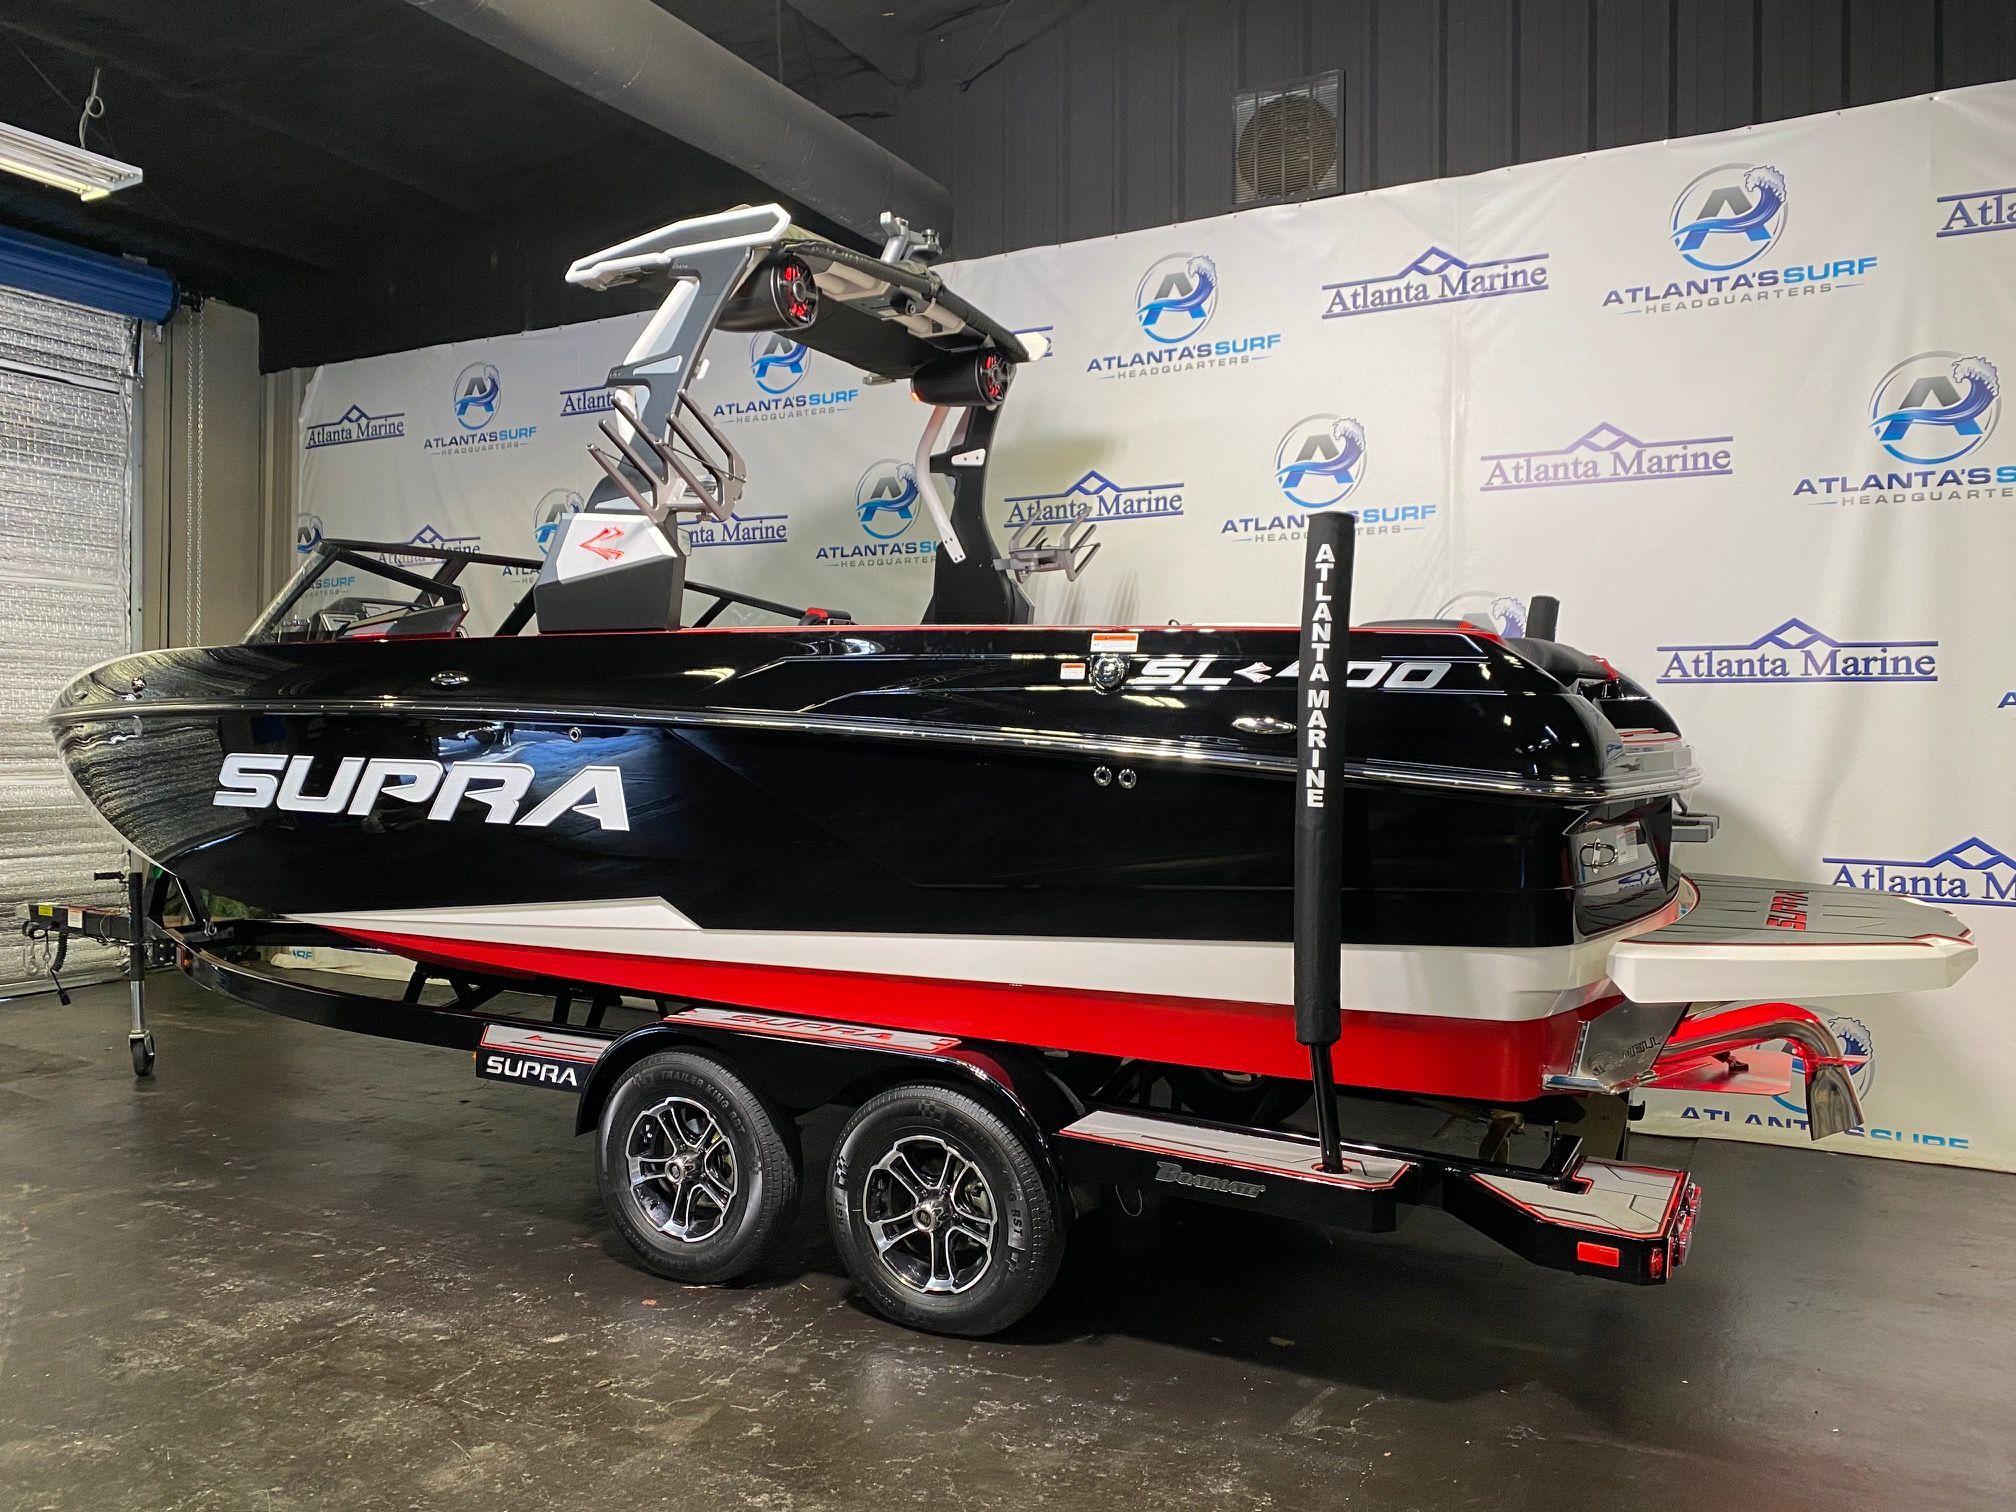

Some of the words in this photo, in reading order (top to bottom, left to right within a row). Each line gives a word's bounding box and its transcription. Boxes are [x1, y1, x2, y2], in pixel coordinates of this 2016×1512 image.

[1325, 279, 1430, 314] Atlanta
[1438, 264, 1547, 298] Marine
[1602, 270, 1779, 307] ATLANTA'S
[1783, 256, 1878, 284] SURF
[1645, 283, 1832, 315] HEADQUARTERS
[1087, 343, 1212, 373] ATLANTA'S
[1215, 333, 1281, 355] SURF
[1117, 355, 1250, 380] HEADQUARTERS
[713, 395, 807, 417] ATLANTA'S
[808, 389, 859, 405] SURF
[736, 406, 835, 424] HEADQUARTERS
[308, 426, 353, 446] Atlanta
[357, 418, 404, 439] Marine
[424, 431, 498, 449] ATLANTA'S
[499, 426, 538, 440] SURF
[441, 441, 519, 457] HEADQUARTERS
[1485, 456, 1600, 486] Atlanta
[1610, 444, 1731, 477] Marine
[1792, 467, 1992, 496] ATLANTA'S
[1007, 499, 1090, 523] Atlanta
[1096, 489, 1183, 517] Marine
[1363, 504, 1437, 524] SURF
[721, 519, 787, 542] Marine
[815, 542, 918, 560] ATLANTA'S
[1309, 543, 1336, 682] ATLANTA
[1134, 659, 1232, 686] SL
[1660, 650, 1790, 678] Atlanta
[1800, 647, 1936, 677] Marine
[1306, 689, 1330, 808] MARINE
[213, 752, 630, 832] SUPRA
[1832, 864, 1969, 898] Atlanta
[1766, 890, 1809, 931] SUPRA
[723, 1014, 893, 1041] SUPRA
[485, 1055, 577, 1087] SUPRA
[661, 1070, 704, 1087] TRAILER
[706, 1084, 730, 1108] KING
